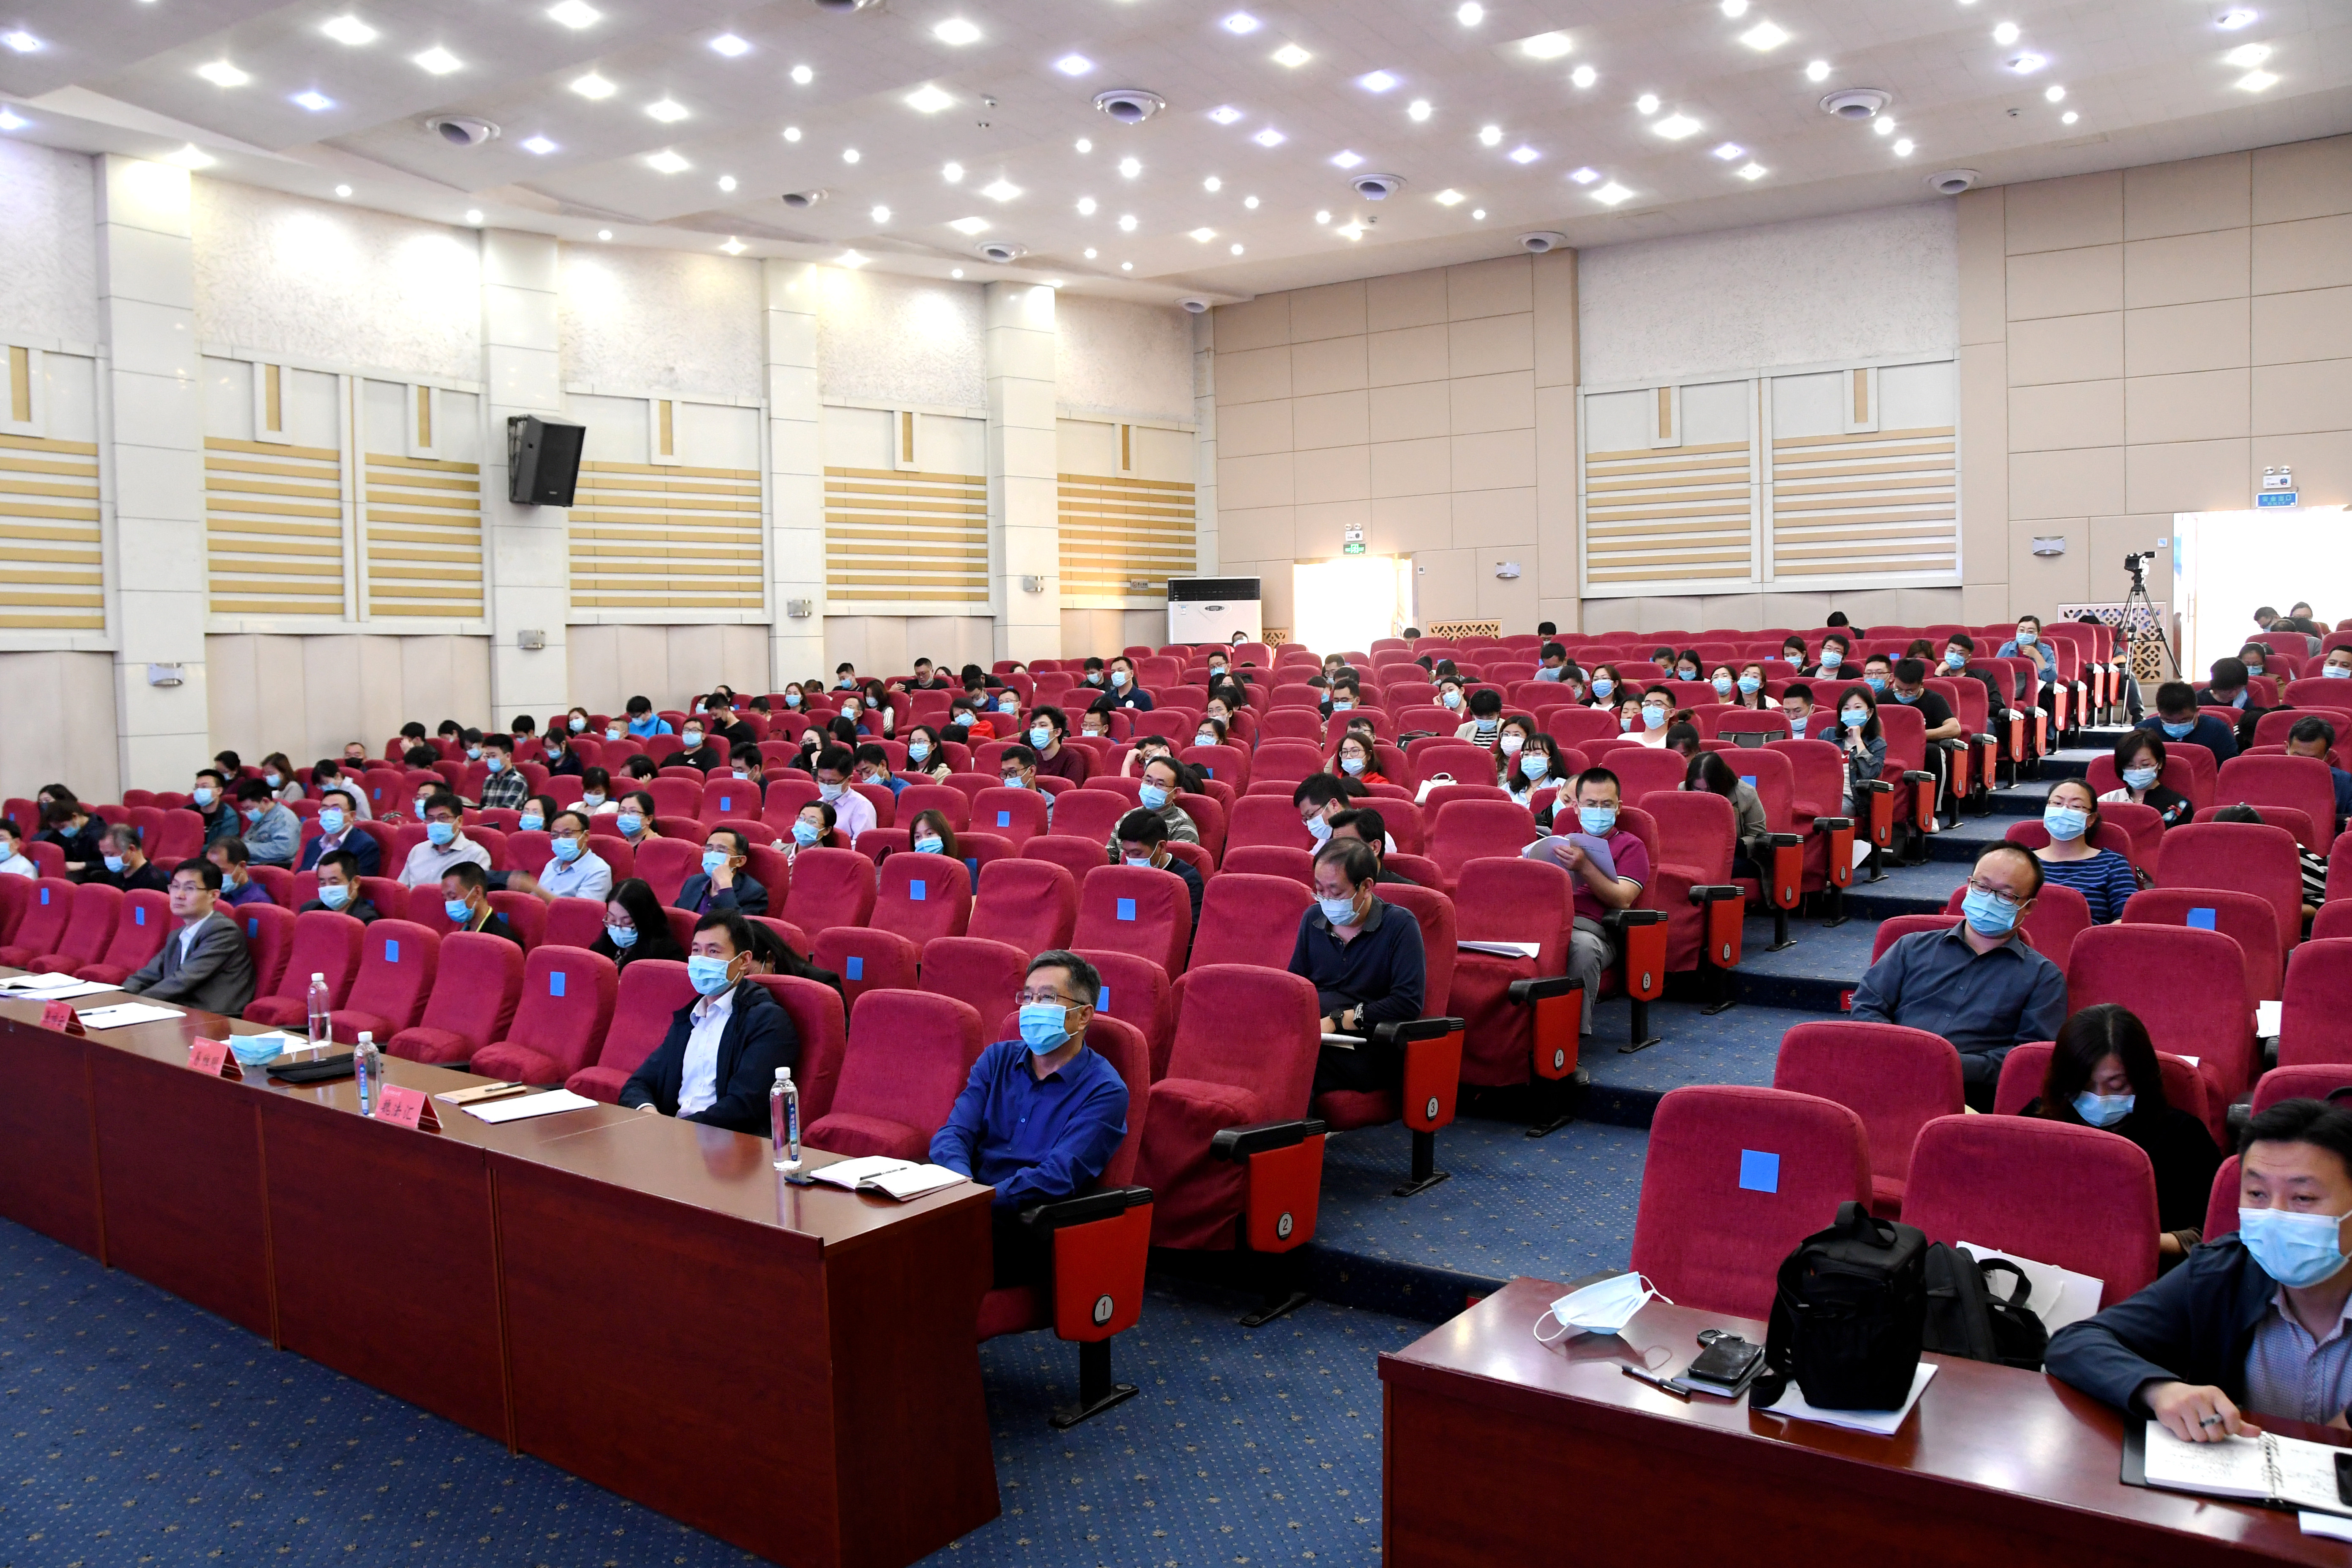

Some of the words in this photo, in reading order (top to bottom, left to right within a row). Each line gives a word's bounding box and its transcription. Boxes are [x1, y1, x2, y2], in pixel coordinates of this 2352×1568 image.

[1645, 976, 1648, 985] 5
[1558, 1053, 1561, 1063] 4
[1431, 1102, 1435, 1113] 3
[1282, 1218, 1288, 1231] 2
[1102, 1300, 1106, 1316] 1
